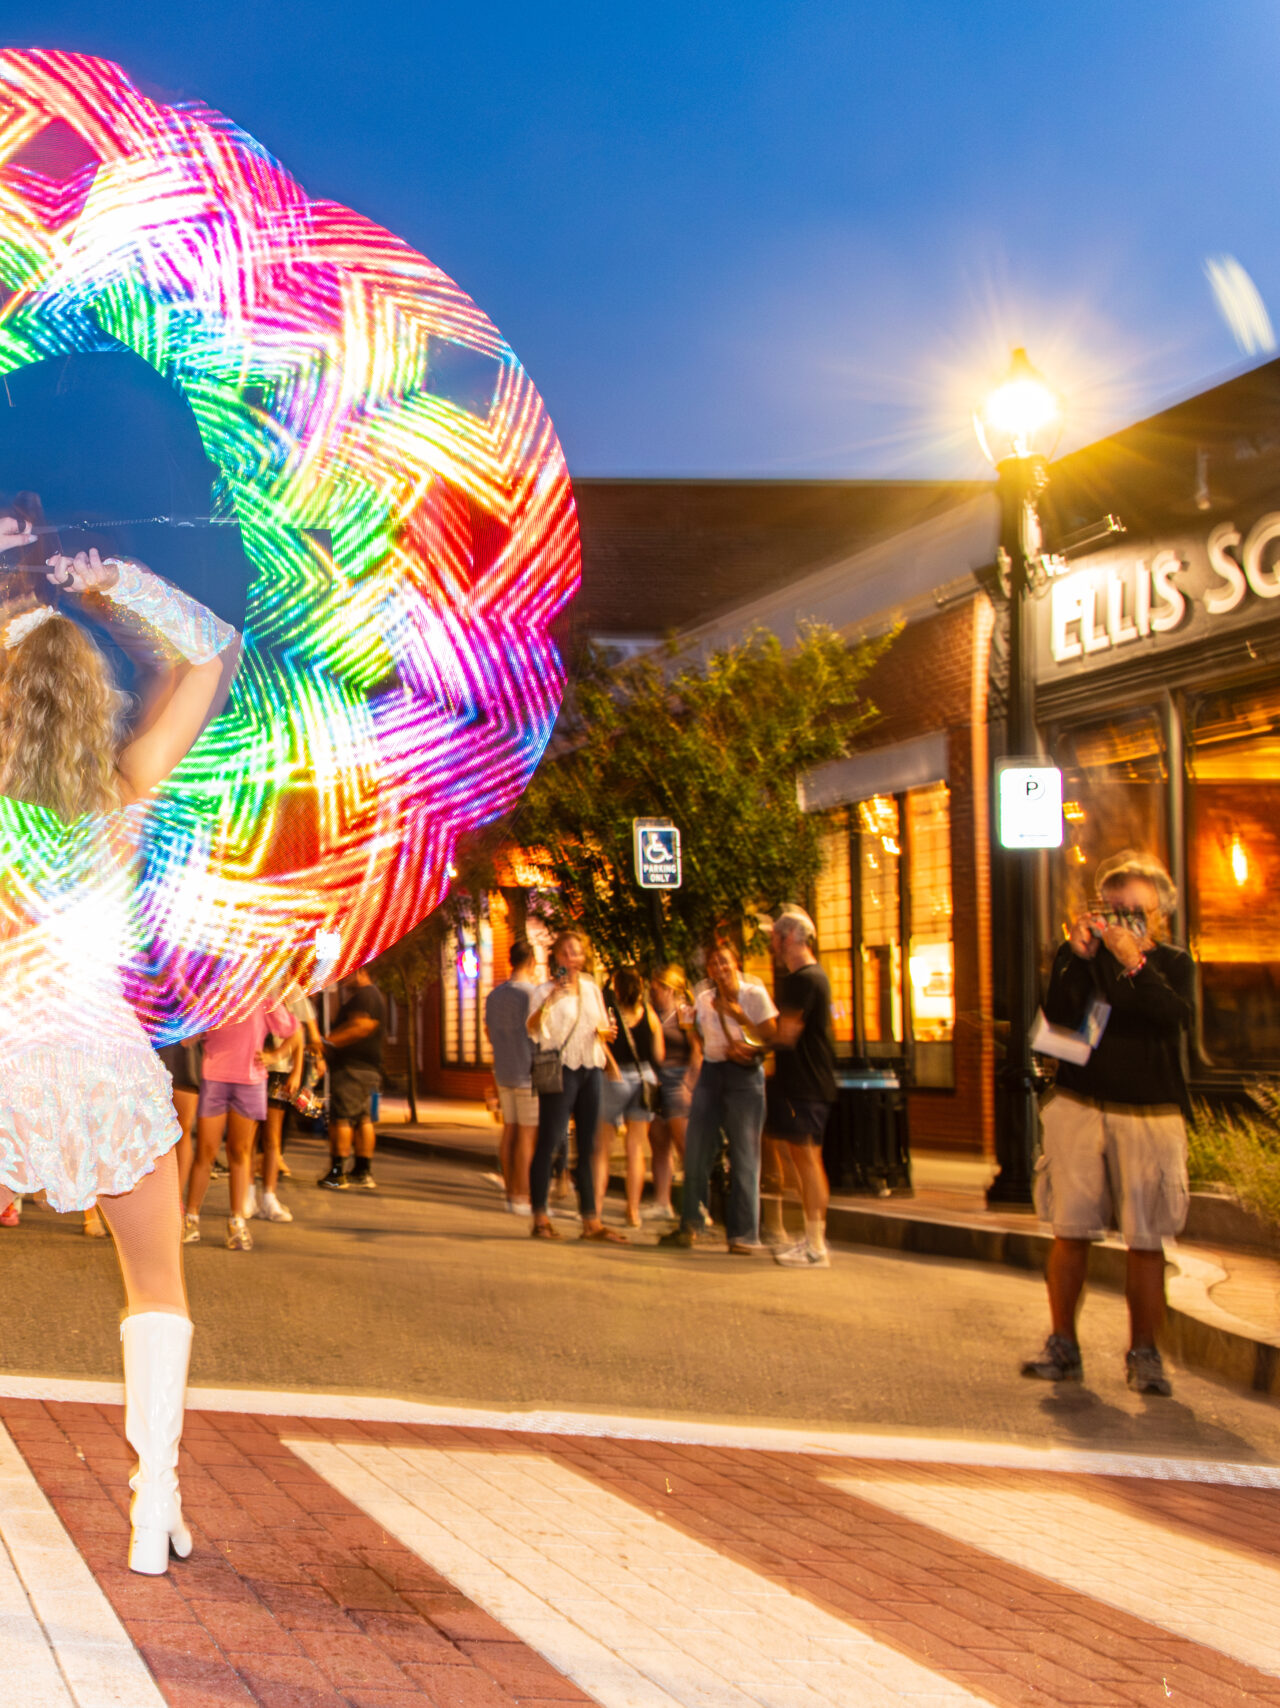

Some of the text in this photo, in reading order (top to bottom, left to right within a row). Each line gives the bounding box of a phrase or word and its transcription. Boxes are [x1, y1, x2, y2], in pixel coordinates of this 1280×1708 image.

[1051, 549, 1186, 663] ELLIS
[1026, 781, 1039, 796] P
[643, 863, 677, 874] PARKING
[649, 873, 671, 883] ONLY
